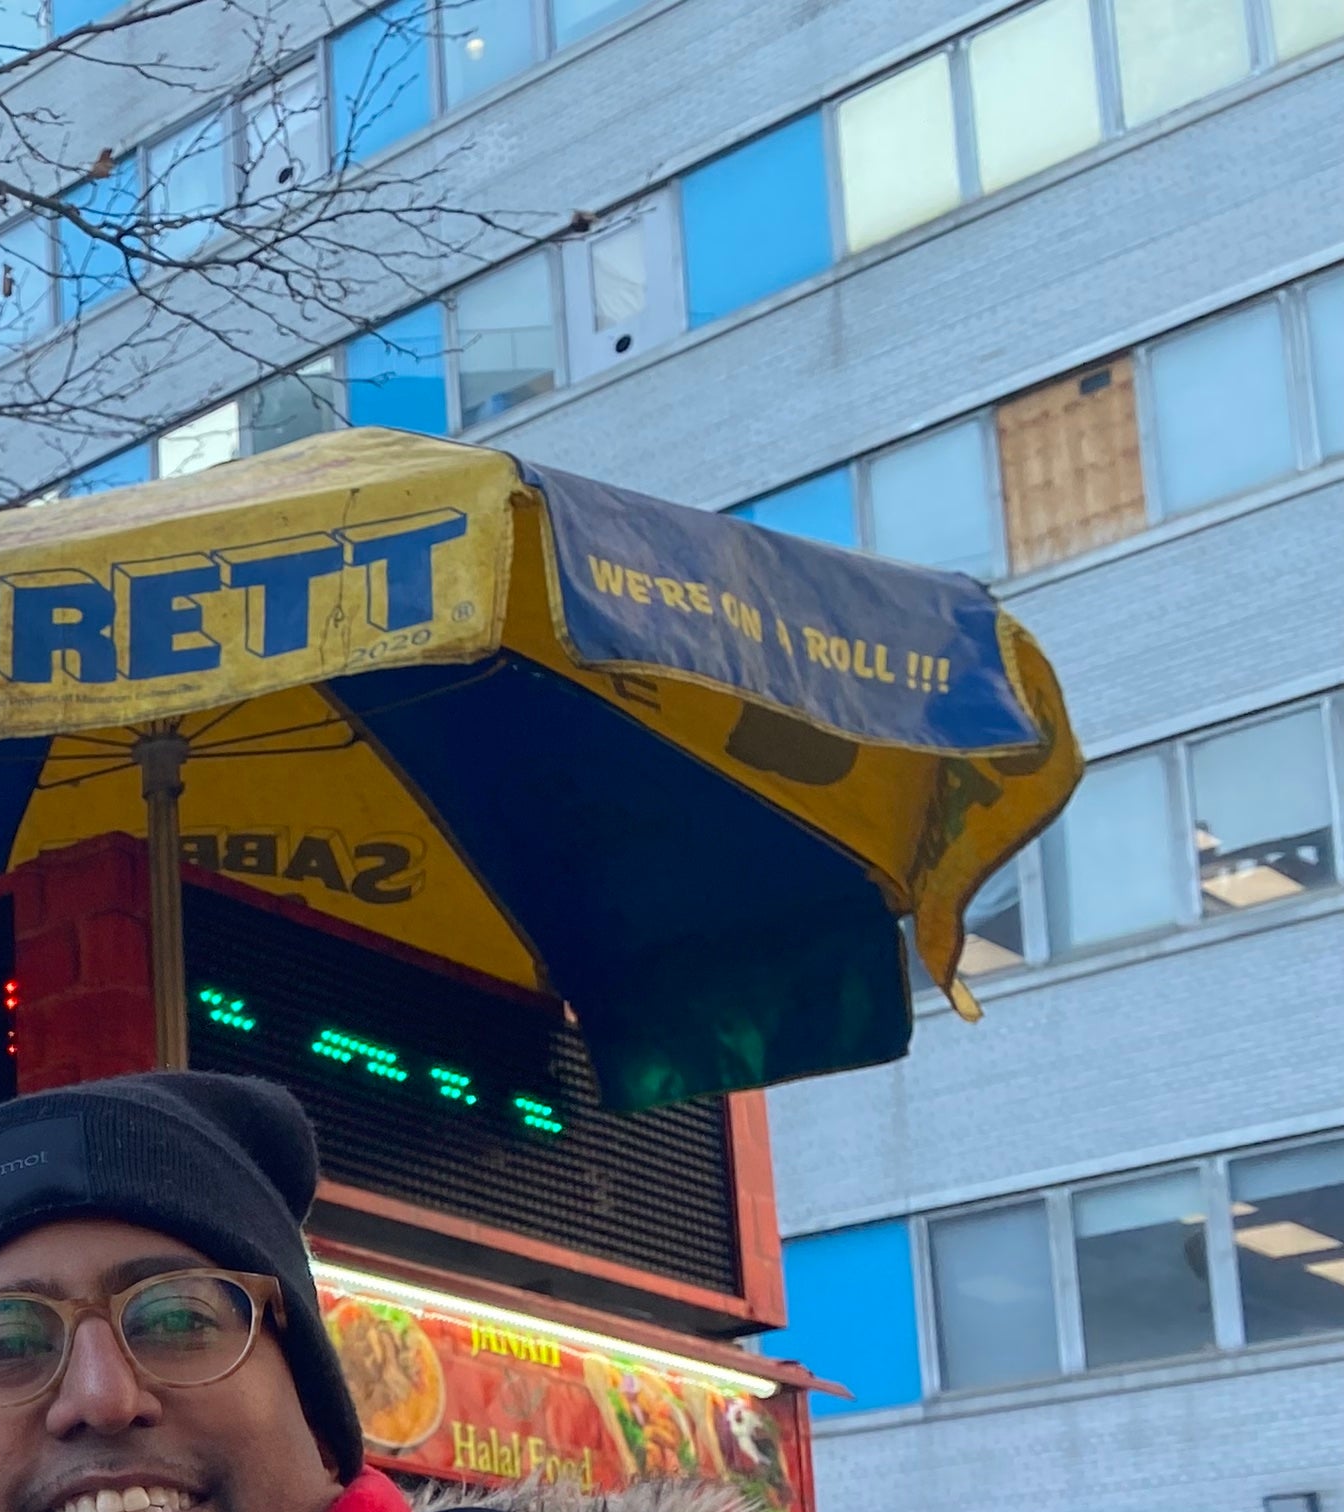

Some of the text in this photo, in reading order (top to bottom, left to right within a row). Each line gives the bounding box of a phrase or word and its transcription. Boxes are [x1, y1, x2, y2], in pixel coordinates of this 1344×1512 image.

[588, 554, 712, 616] WE'RE
[722, 594, 763, 645] ON
[804, 627, 895, 688] ROLL
[451, 1420, 521, 1480] Halal
